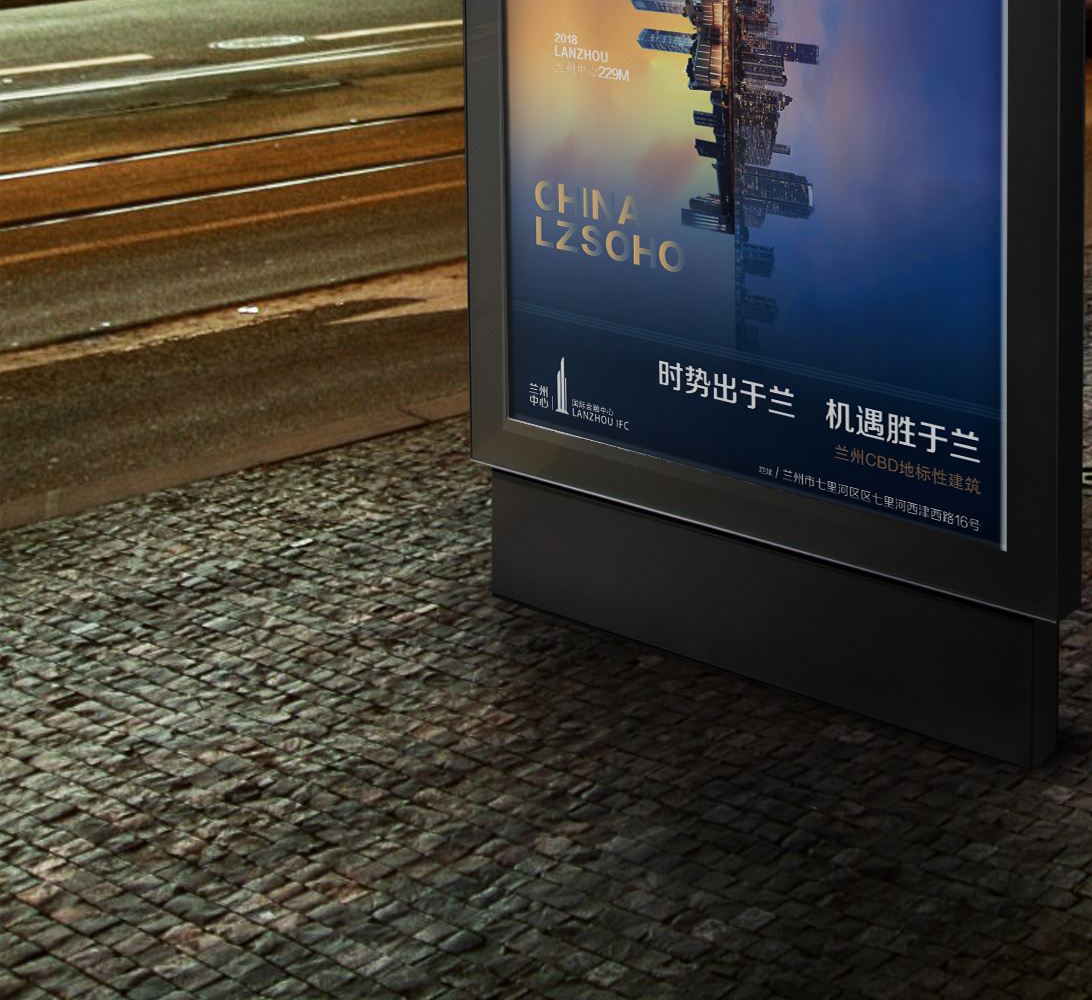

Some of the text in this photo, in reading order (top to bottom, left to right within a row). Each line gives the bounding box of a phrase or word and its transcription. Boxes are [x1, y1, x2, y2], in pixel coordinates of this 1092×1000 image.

[554, 32, 578, 45] 2018
[554, 45, 609, 63] LANZHOU
[534, 180, 640, 228] CHINA
[535, 216, 685, 273] LZSOHO
[529, 382, 549, 397] 兰州
[529, 395, 549, 409] 中心
[658, 359, 981, 463] 时势出于兰 机遇胜于兰
[572, 407, 629, 431] LANZHOU IFC
[834, 444, 981, 495] 兰州CBD地标性建筑
